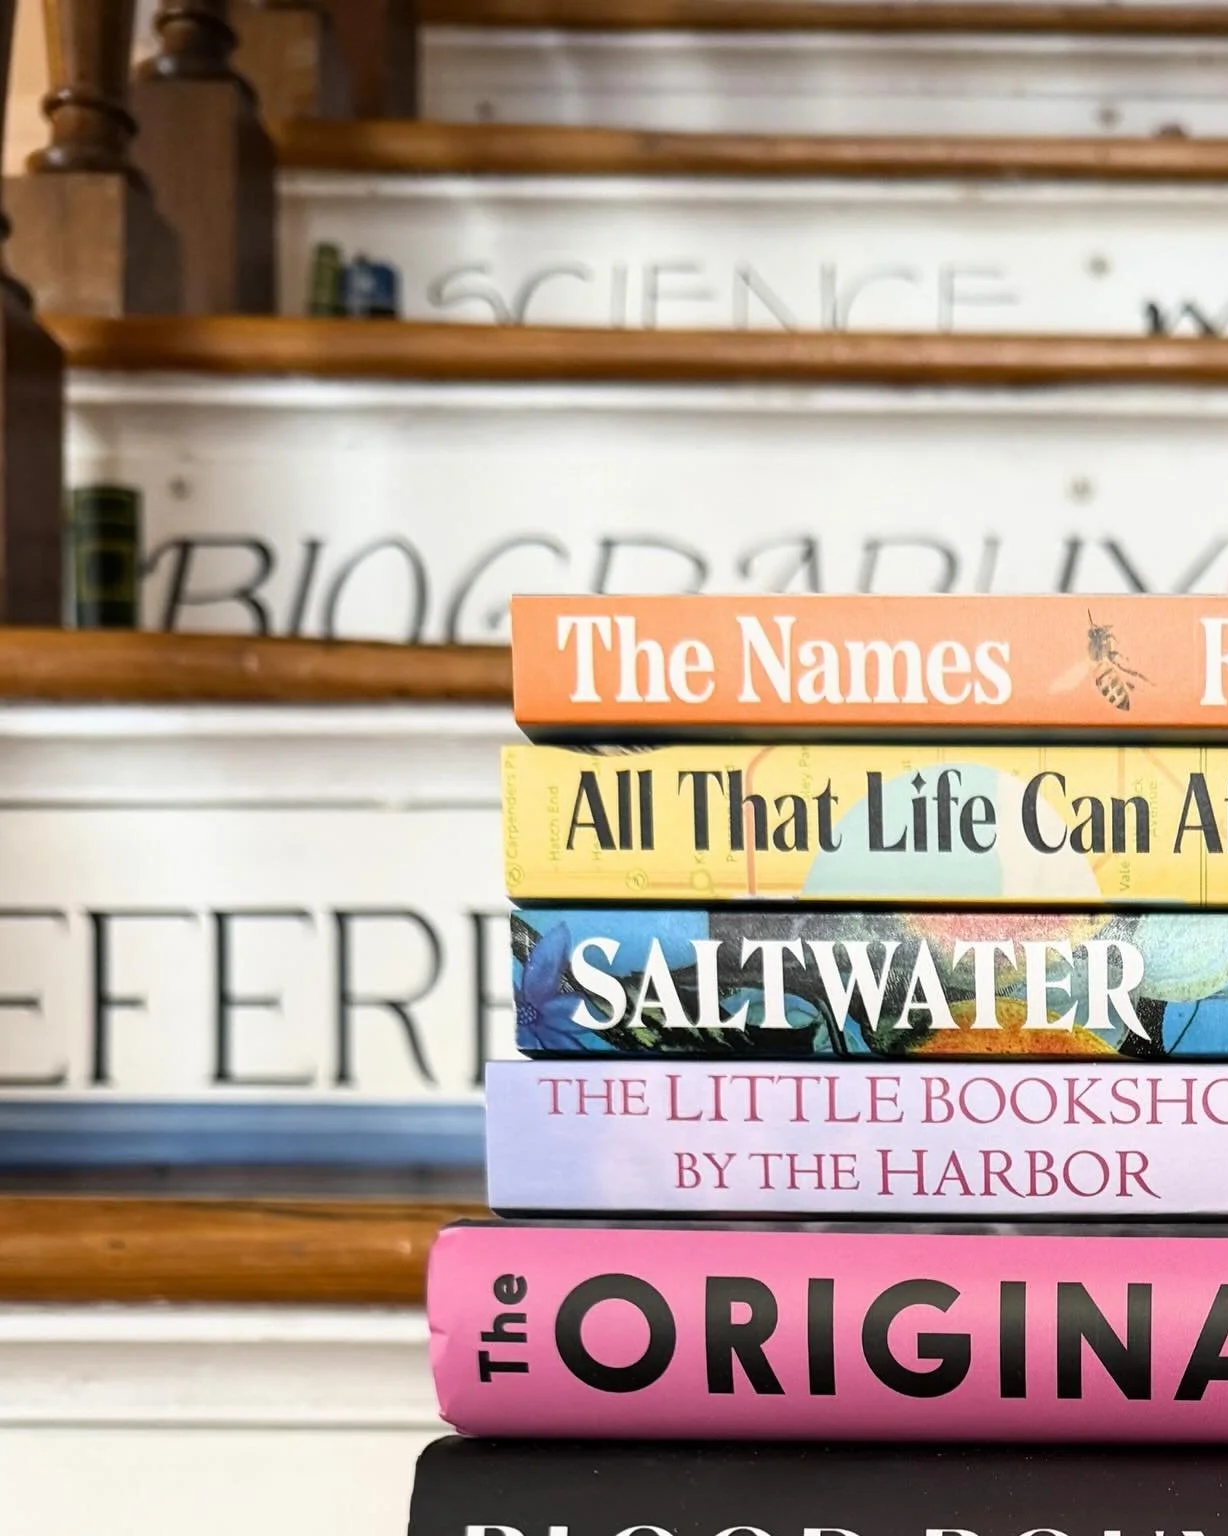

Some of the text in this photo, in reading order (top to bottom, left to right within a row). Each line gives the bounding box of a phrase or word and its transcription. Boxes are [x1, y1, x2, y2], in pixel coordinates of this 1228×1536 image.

[556, 615, 1012, 705] The Names
[546, 785, 560, 814] End
[565, 769, 654, 853] All
[677, 769, 843, 853] That
[866, 769, 998, 853] Life
[1020, 770, 1150, 854] Can
[1118, 860, 1131, 892] Vale
[570, 936, 1152, 1041] SALTWATER
[537, 1077, 651, 1118] THE
[665, 1073, 906, 1124] LITTLE
[674, 1148, 1162, 1199] BY THE HARBOR
[477, 1273, 530, 1383] The
